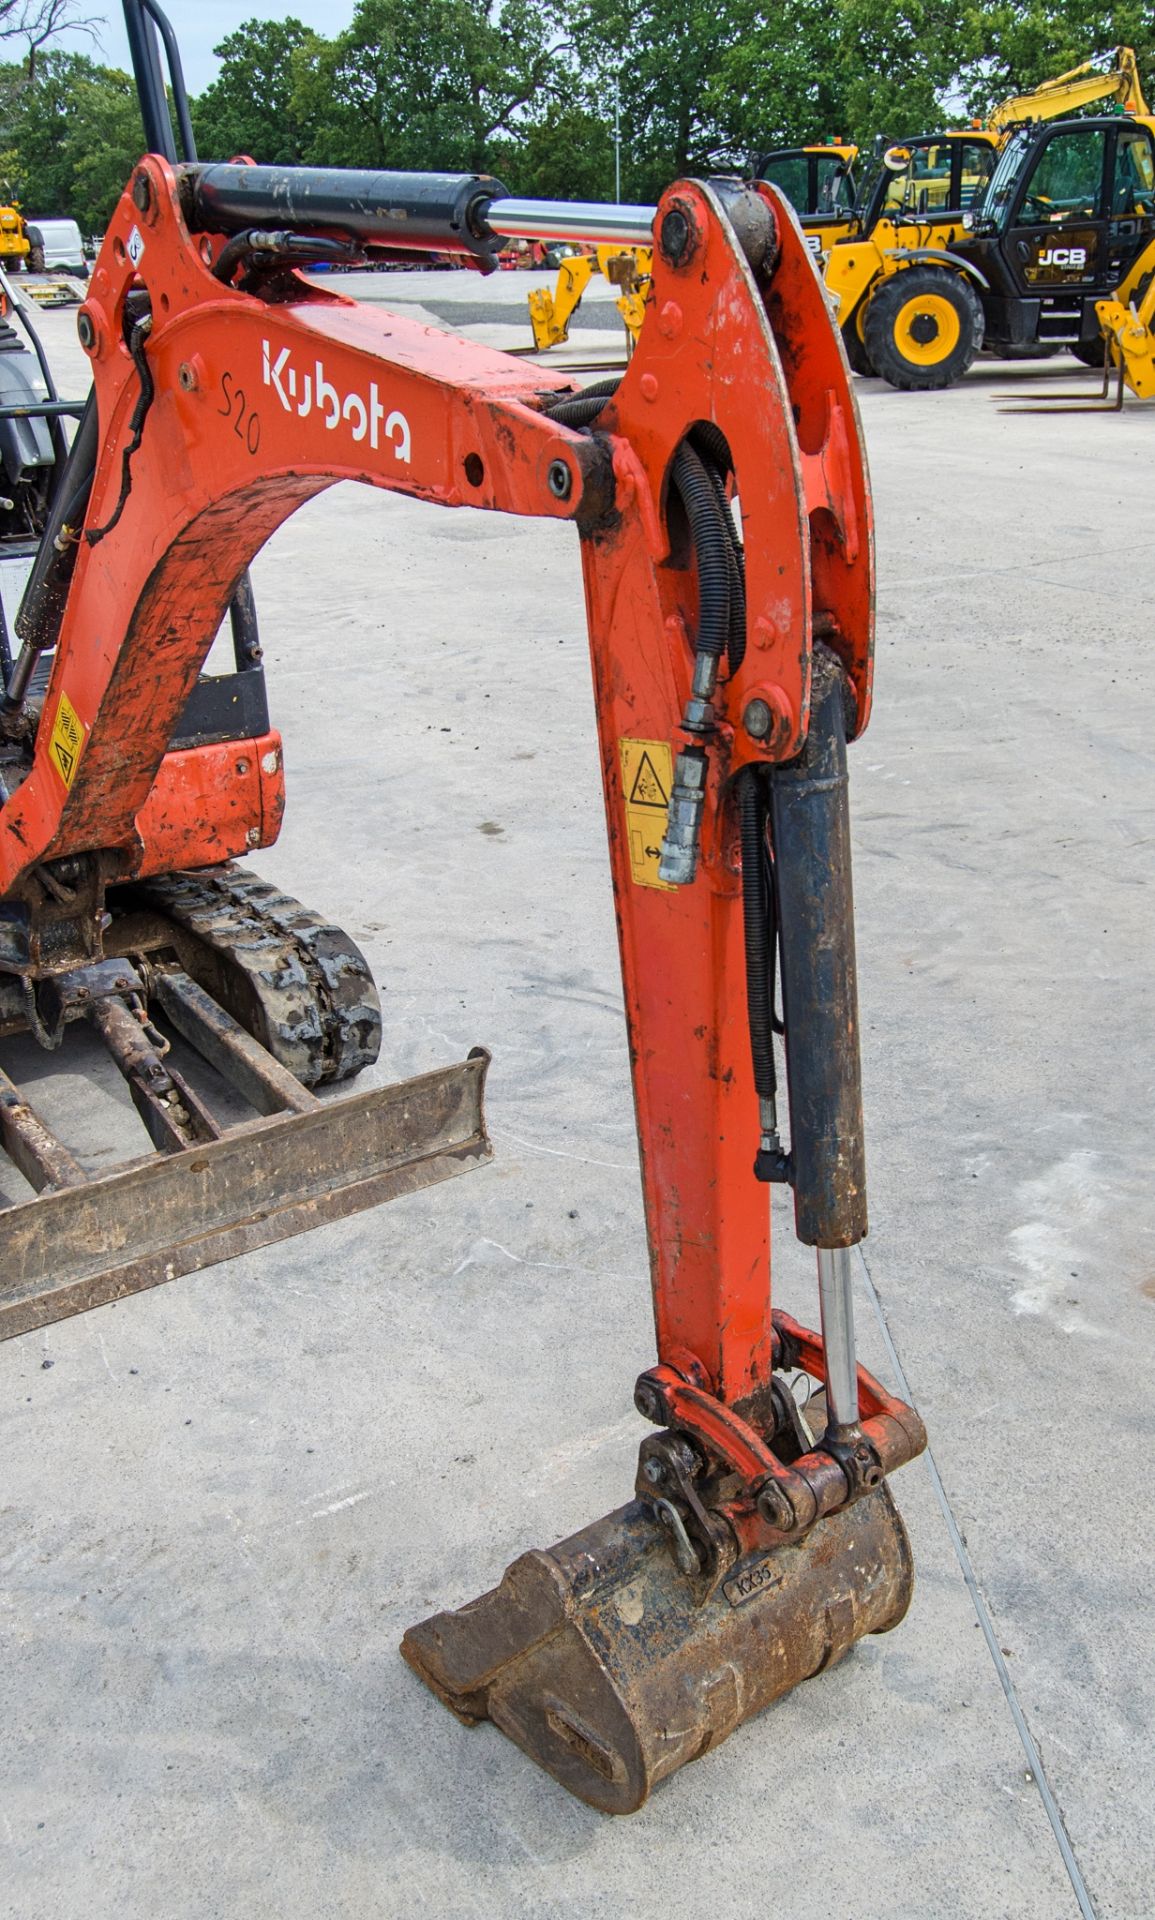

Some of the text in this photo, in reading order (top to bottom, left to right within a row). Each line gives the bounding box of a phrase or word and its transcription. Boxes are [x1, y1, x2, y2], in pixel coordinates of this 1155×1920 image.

[1038, 248, 1086, 266] JCB
[217, 371, 261, 455] S20
[262, 338, 411, 464] Kubota
